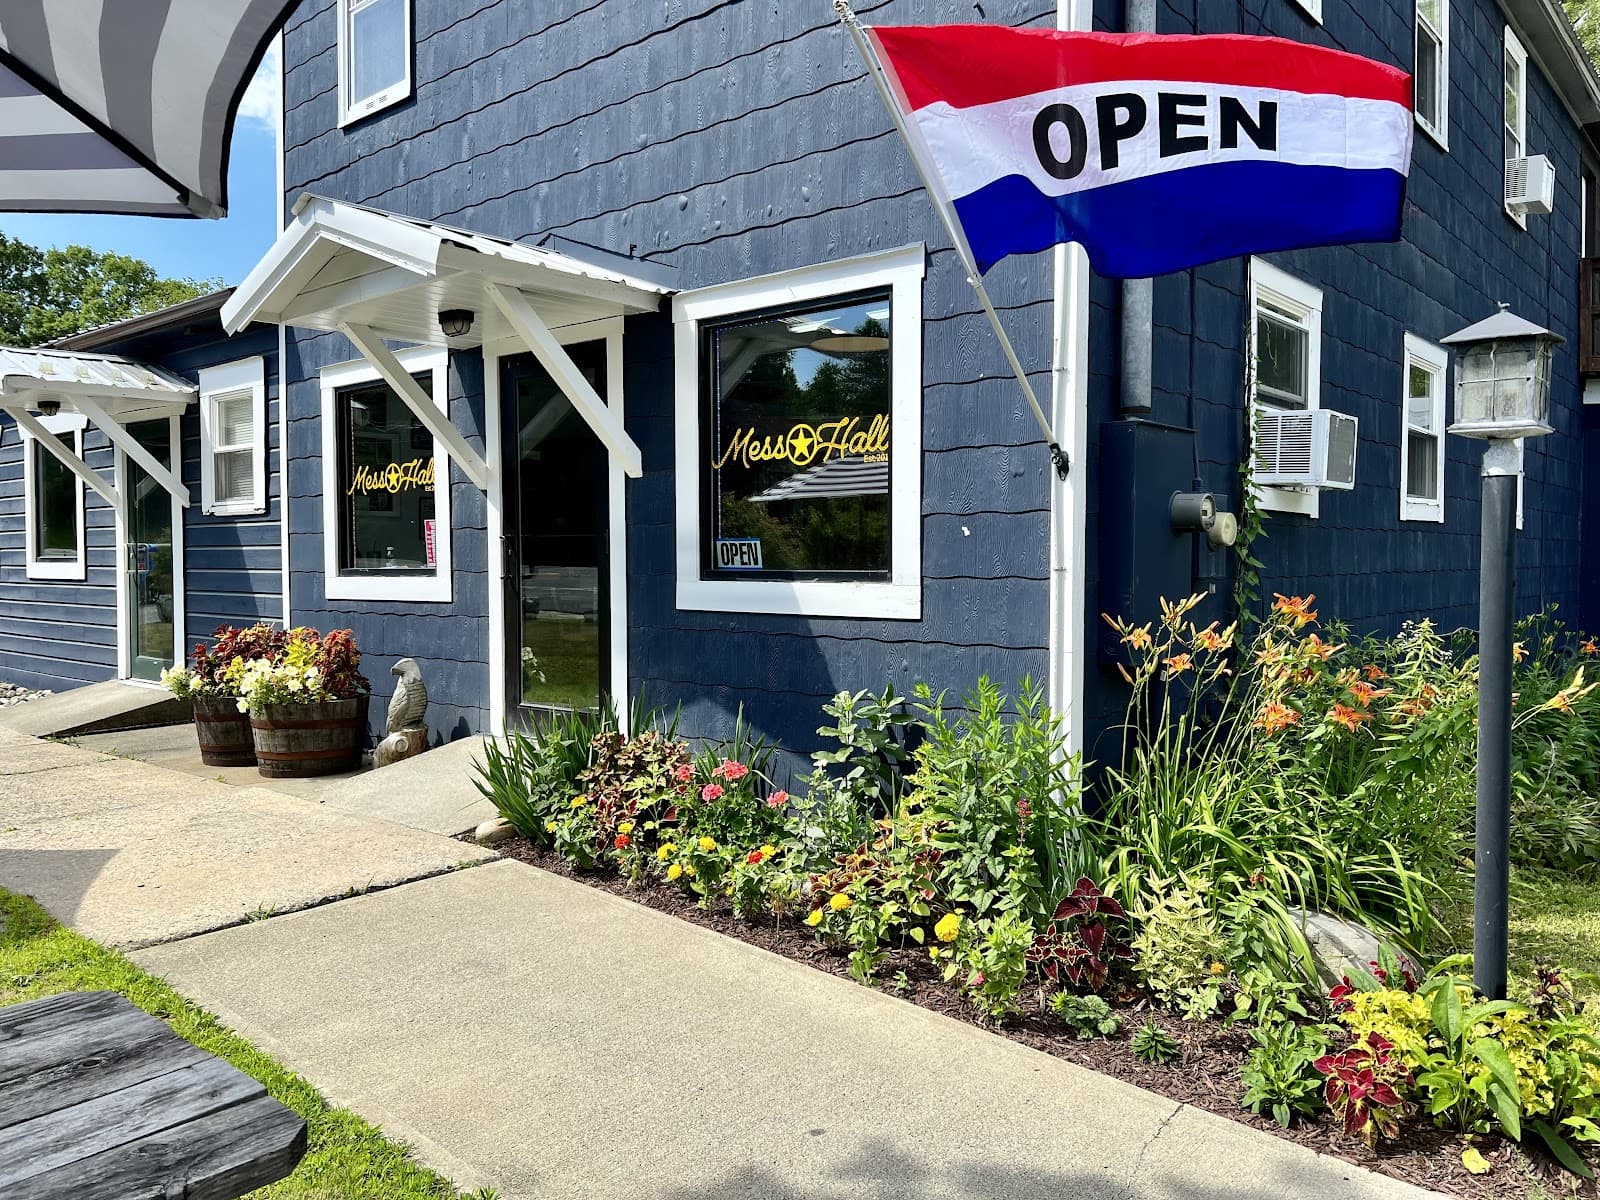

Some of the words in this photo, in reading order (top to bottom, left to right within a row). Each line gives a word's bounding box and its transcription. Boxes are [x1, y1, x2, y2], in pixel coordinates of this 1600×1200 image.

[1032, 92, 1278, 180] OPEN
[711, 427, 788, 469] Mess
[816, 413, 889, 462] Hall
[346, 465, 387, 495] Mess
[400, 457, 434, 491] Hal
[720, 543, 759, 566] OPEN
